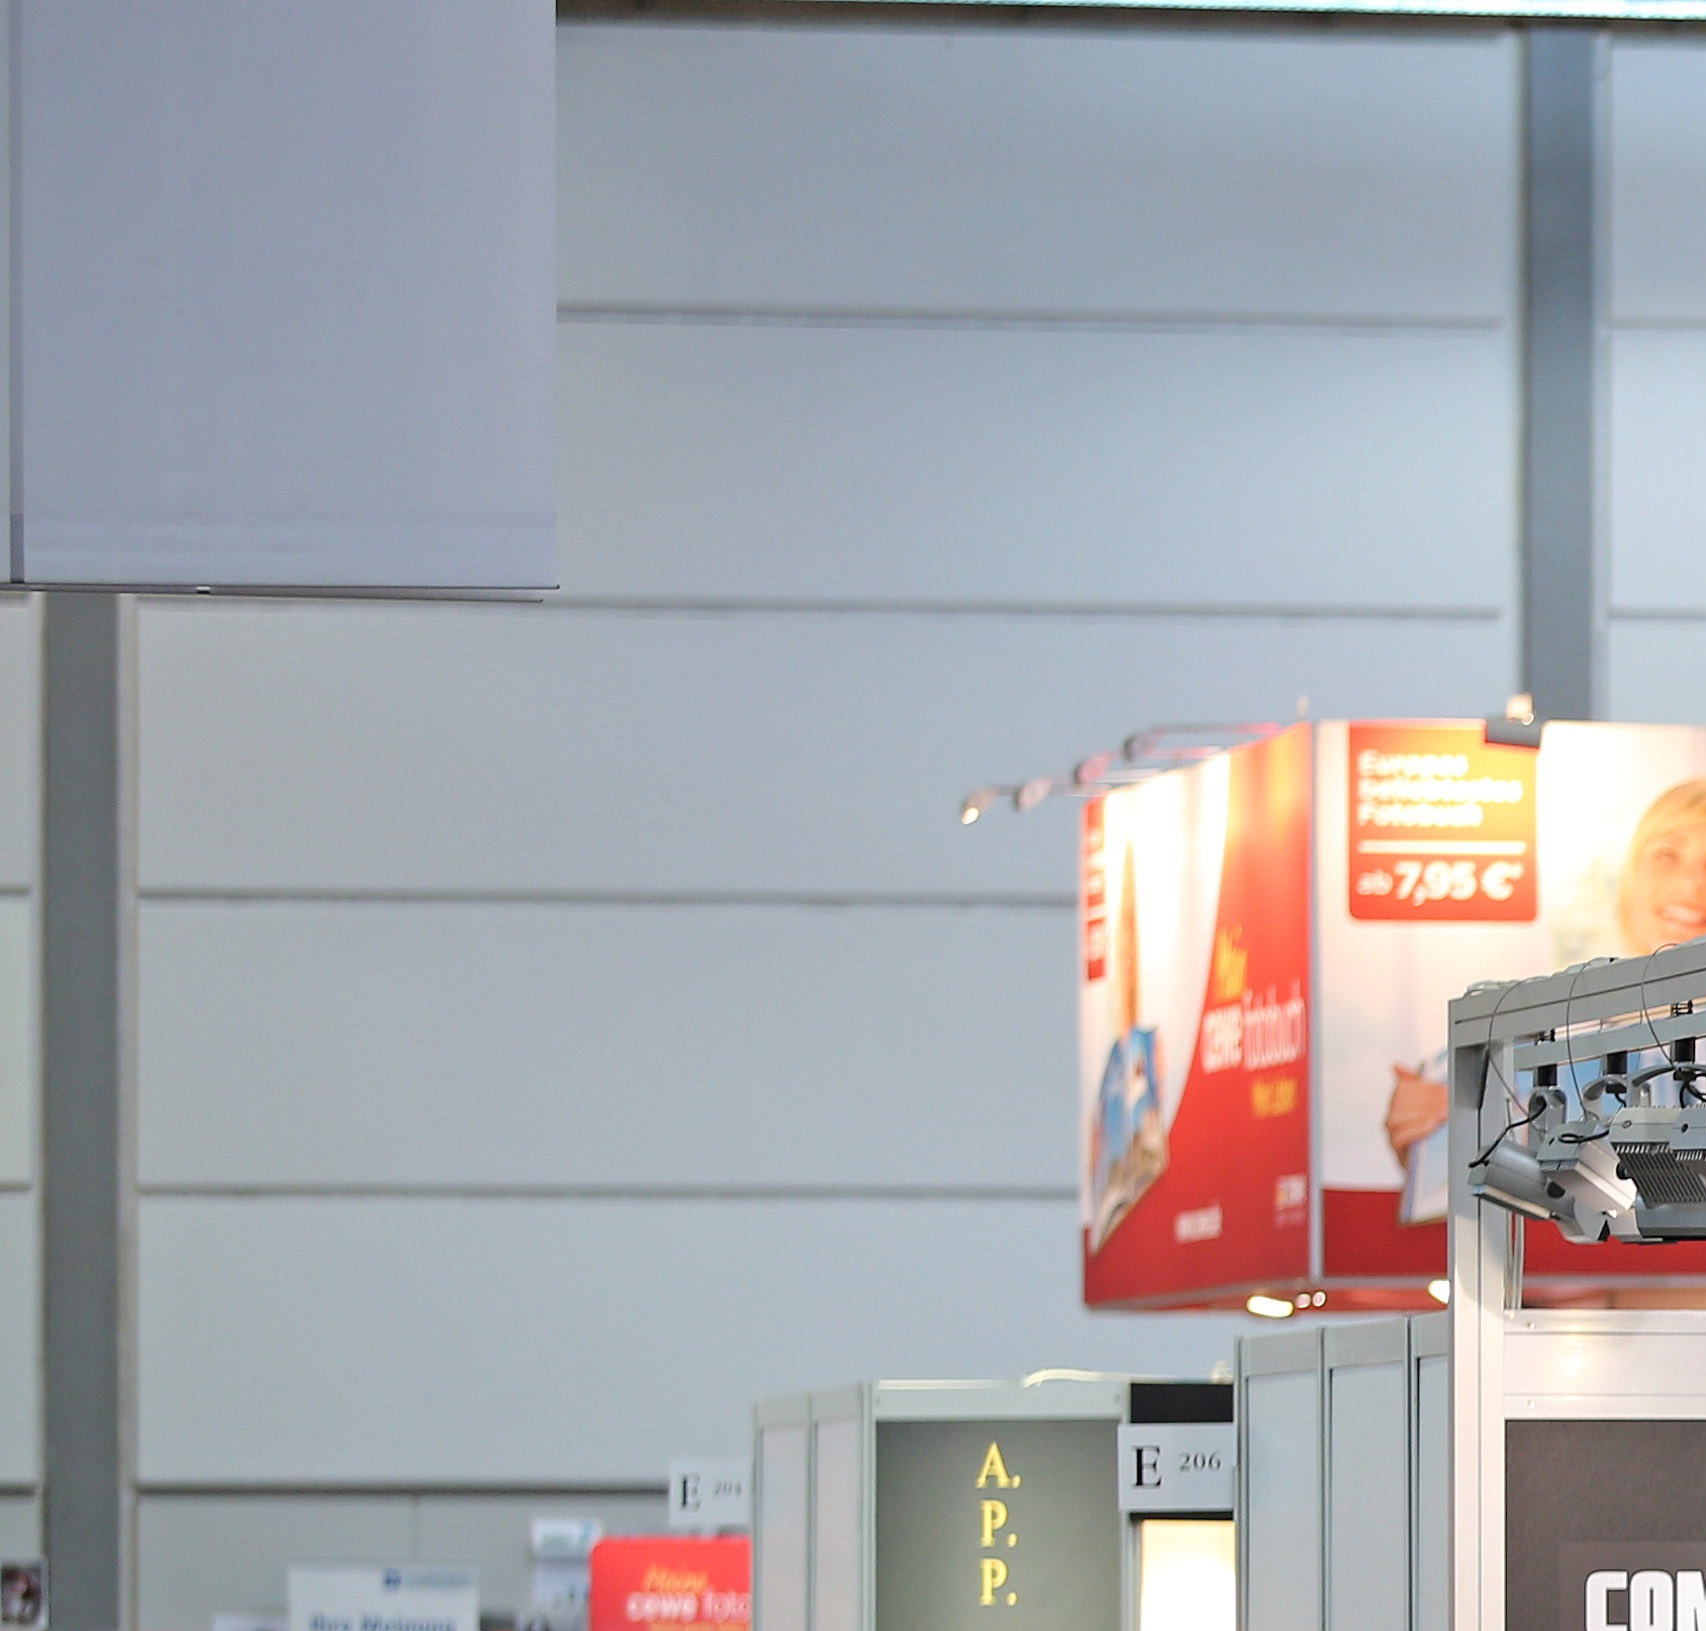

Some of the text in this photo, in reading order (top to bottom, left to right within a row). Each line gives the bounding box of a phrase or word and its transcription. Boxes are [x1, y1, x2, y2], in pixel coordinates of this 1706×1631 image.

[1357, 868, 1394, 896] ab
[1394, 860, 1477, 907] 7,95
[1131, 1445, 1221, 1488] E 206
